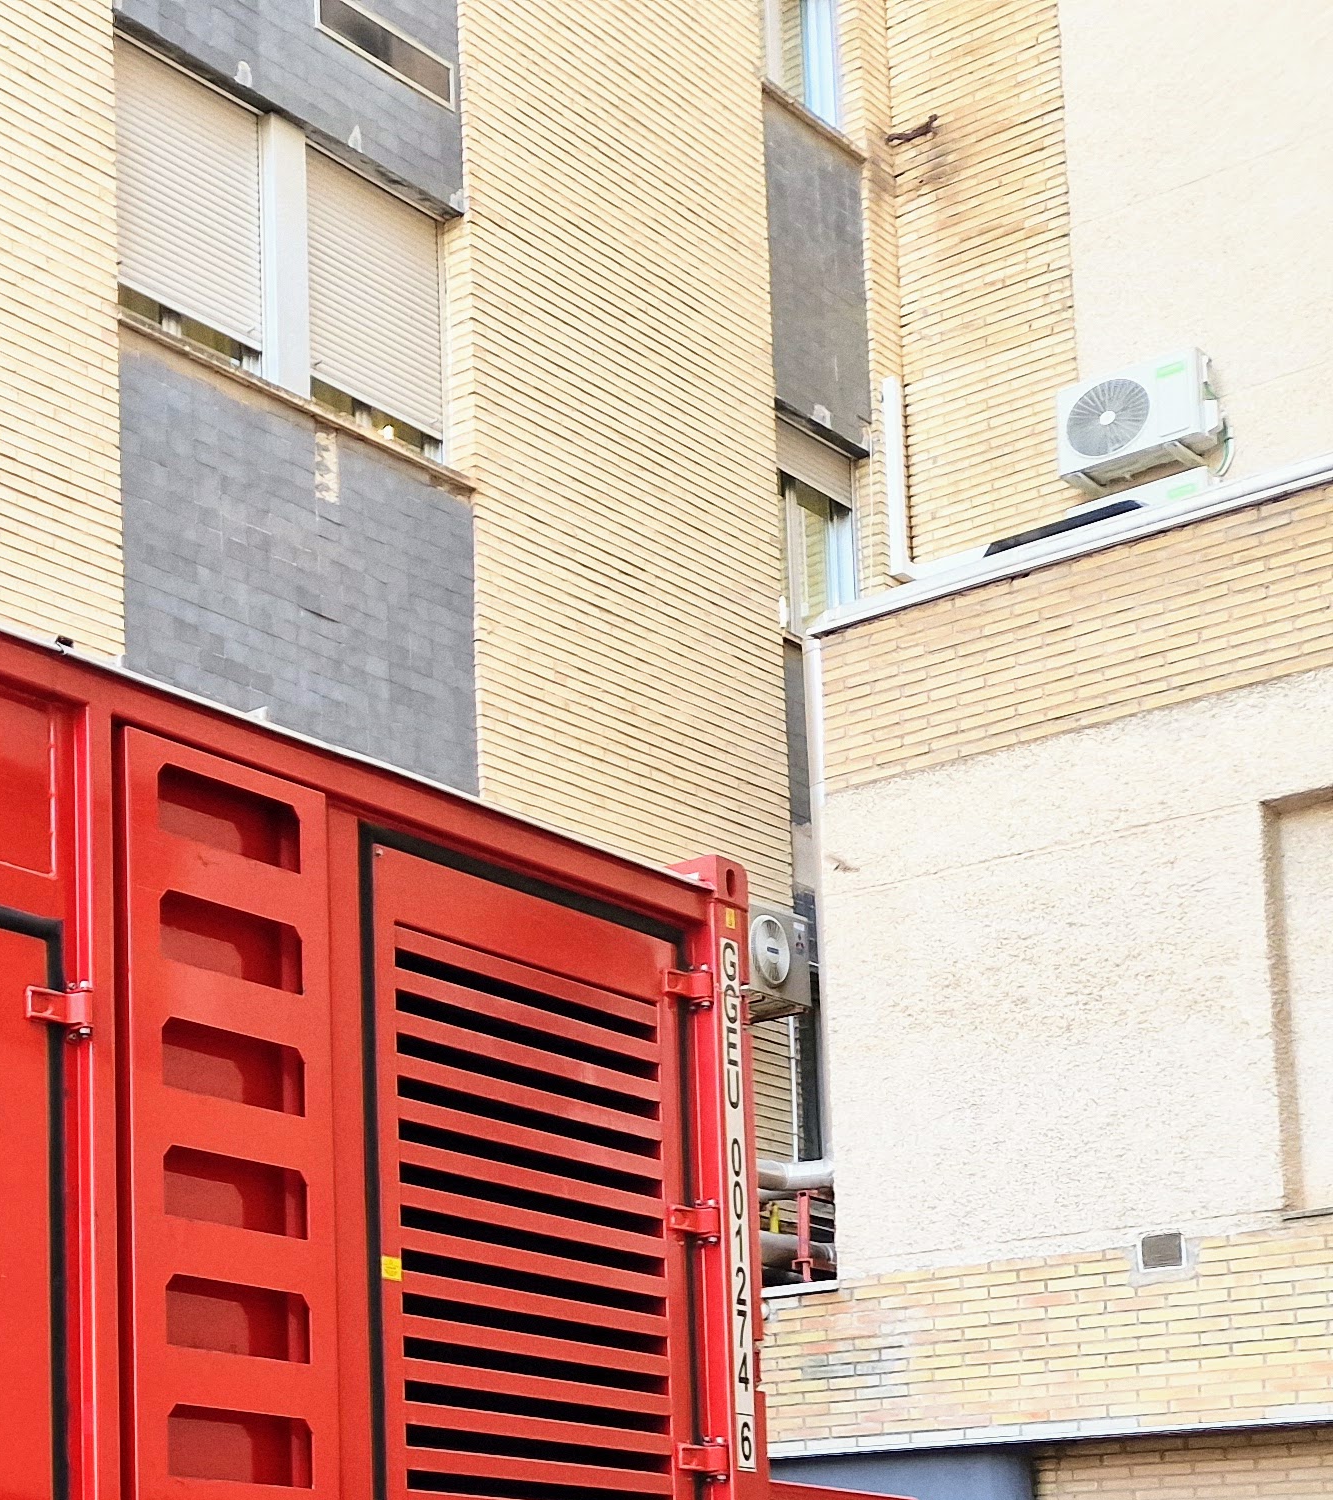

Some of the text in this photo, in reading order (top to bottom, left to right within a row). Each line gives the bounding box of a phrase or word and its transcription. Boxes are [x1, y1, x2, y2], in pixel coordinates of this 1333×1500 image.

[723, 941, 753, 1463] GGEU 001274 6
